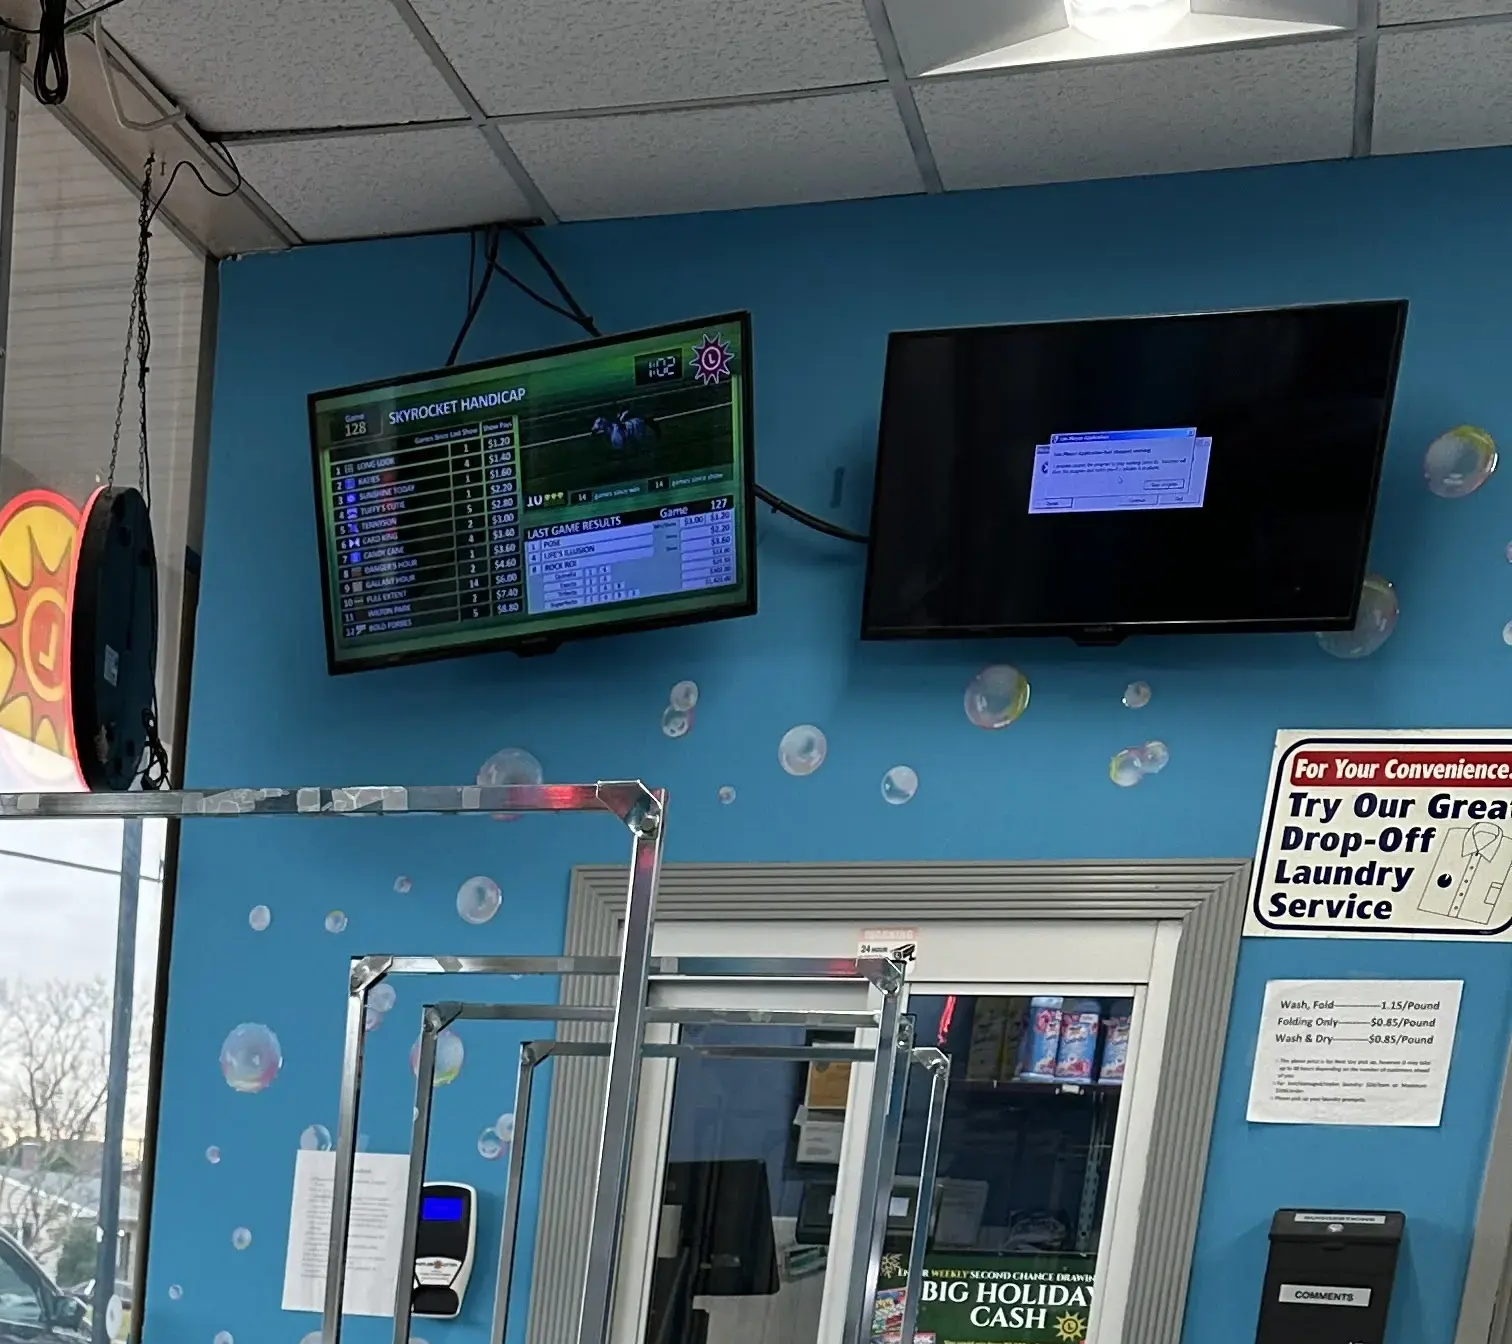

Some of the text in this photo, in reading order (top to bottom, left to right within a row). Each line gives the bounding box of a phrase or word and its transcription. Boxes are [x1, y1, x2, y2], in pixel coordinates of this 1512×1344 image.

[389, 387, 526, 425] SKYROCKET HANDICAP
[345, 412, 365, 423] Game
[345, 422, 367, 437] 128
[336, 467, 341, 476] 1
[464, 444, 469, 453] 1
[488, 436, 511, 449] $1.20
[337, 481, 342, 490] 2
[464, 459, 470, 468] 4
[489, 452, 511, 464] $1.40
[338, 496, 344, 505] 3
[393, 484, 415, 495] TODAY
[465, 474, 470, 483] 1
[489, 467, 512, 480] $1.60
[655, 480, 664, 489] 14
[339, 511, 345, 519] 4
[466, 490, 471, 498] 1
[490, 483, 513, 495] $2.20
[527, 495, 543, 508] 10
[578, 493, 587, 501] 14
[467, 504, 473, 513] 5
[527, 498, 728, 540] LAST GAME RESULTS Game 127
[468, 519, 473, 529] 2
[492, 513, 514, 525] $3.00
[342, 555, 348, 564] 7
[398, 559, 418, 568] HOUR
[469, 550, 475, 559] 1
[344, 584, 350, 593] 9
[396, 574, 416, 584] HOUR
[470, 564, 476, 573] 2
[494, 558, 517, 570] $4.60
[344, 598, 354, 608] 10
[469, 579, 479, 588] 14
[495, 573, 518, 585] $6.00
[345, 613, 354, 622] 11
[496, 588, 518, 600] $7.40
[472, 608, 479, 618] 5
[1294, 758, 1328, 779] For
[1335, 758, 1380, 780] Your
[1289, 792, 1512, 823] Try Our Grea
[1280, 825, 1437, 858] Drop-Off
[1274, 859, 1415, 893] Laundry
[1268, 892, 1393, 920] Service
[1280, 1000, 1310, 1011] Wash,
[1277, 1017, 1313, 1028] Folding
[1315, 1017, 1339, 1028] Only
[1275, 1034, 1302, 1043] Wash
[1305, 1034, 1313, 1043] &
[1315, 1033, 1334, 1045] Dry
[931, 1268, 969, 1279] WEEKLY
[969, 1270, 1012, 1280] SECOND
[1012, 1271, 1055, 1282] CHANCE
[922, 1280, 969, 1303] BIG
[1294, 1290, 1355, 1302] COMMENTS
[970, 1306, 1048, 1329] CASH
